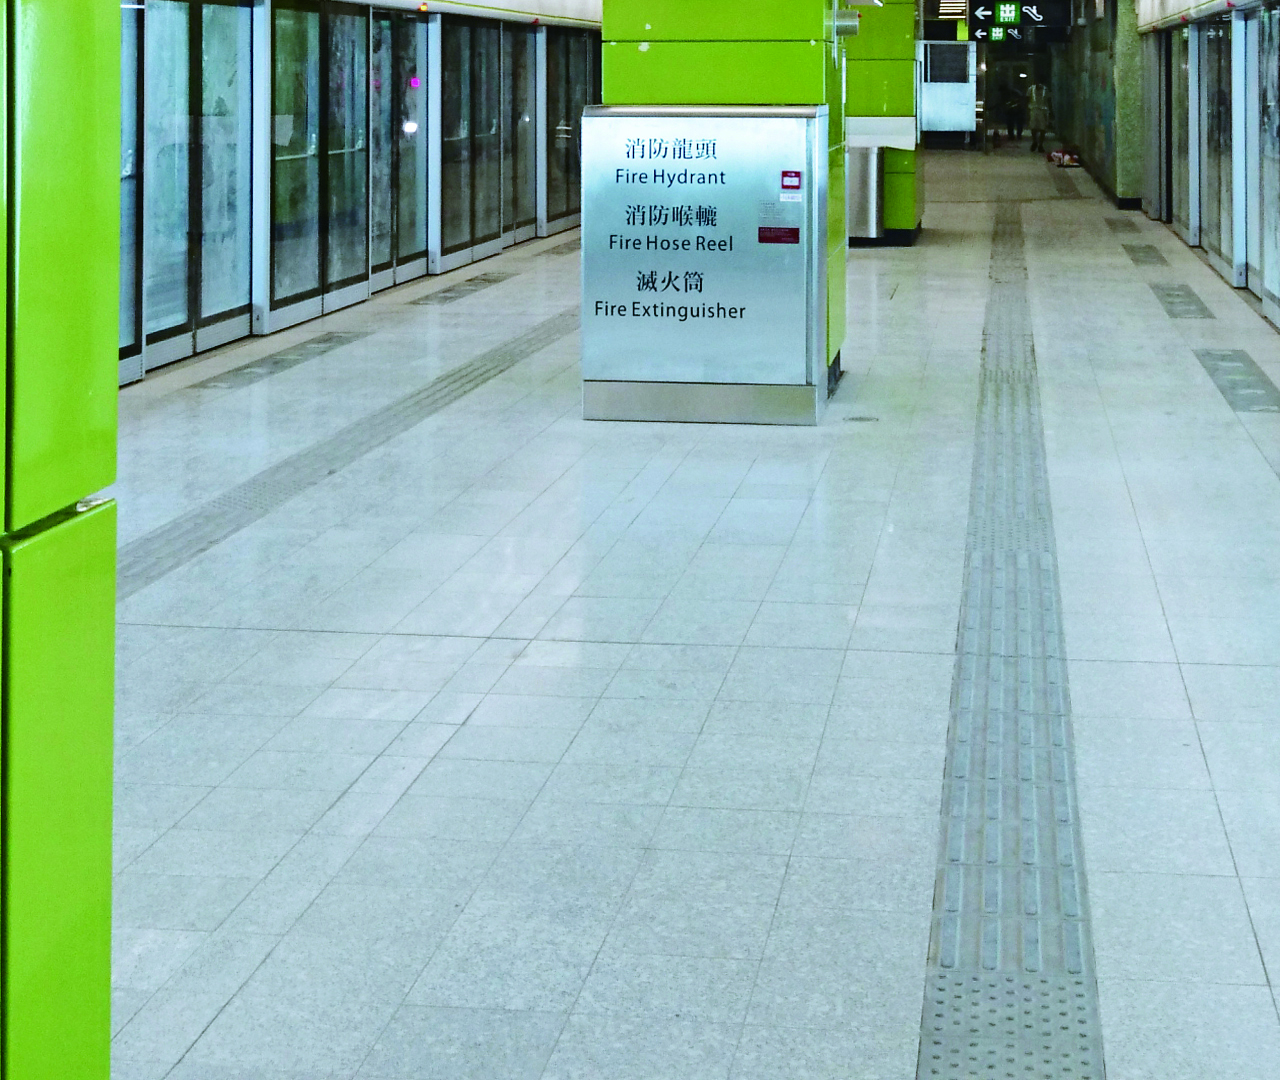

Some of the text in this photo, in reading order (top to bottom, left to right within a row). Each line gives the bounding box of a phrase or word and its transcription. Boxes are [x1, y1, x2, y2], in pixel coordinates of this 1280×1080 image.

[625, 138, 717, 160] 消防龍頭
[616, 168, 726, 188] Fire Hydrant
[625, 204, 717, 227] 消防喉轆
[609, 234, 733, 252] Fire Hose Reel
[636, 270, 704, 293] 滅火筒
[595, 300, 746, 322] Fire Extinguisher
